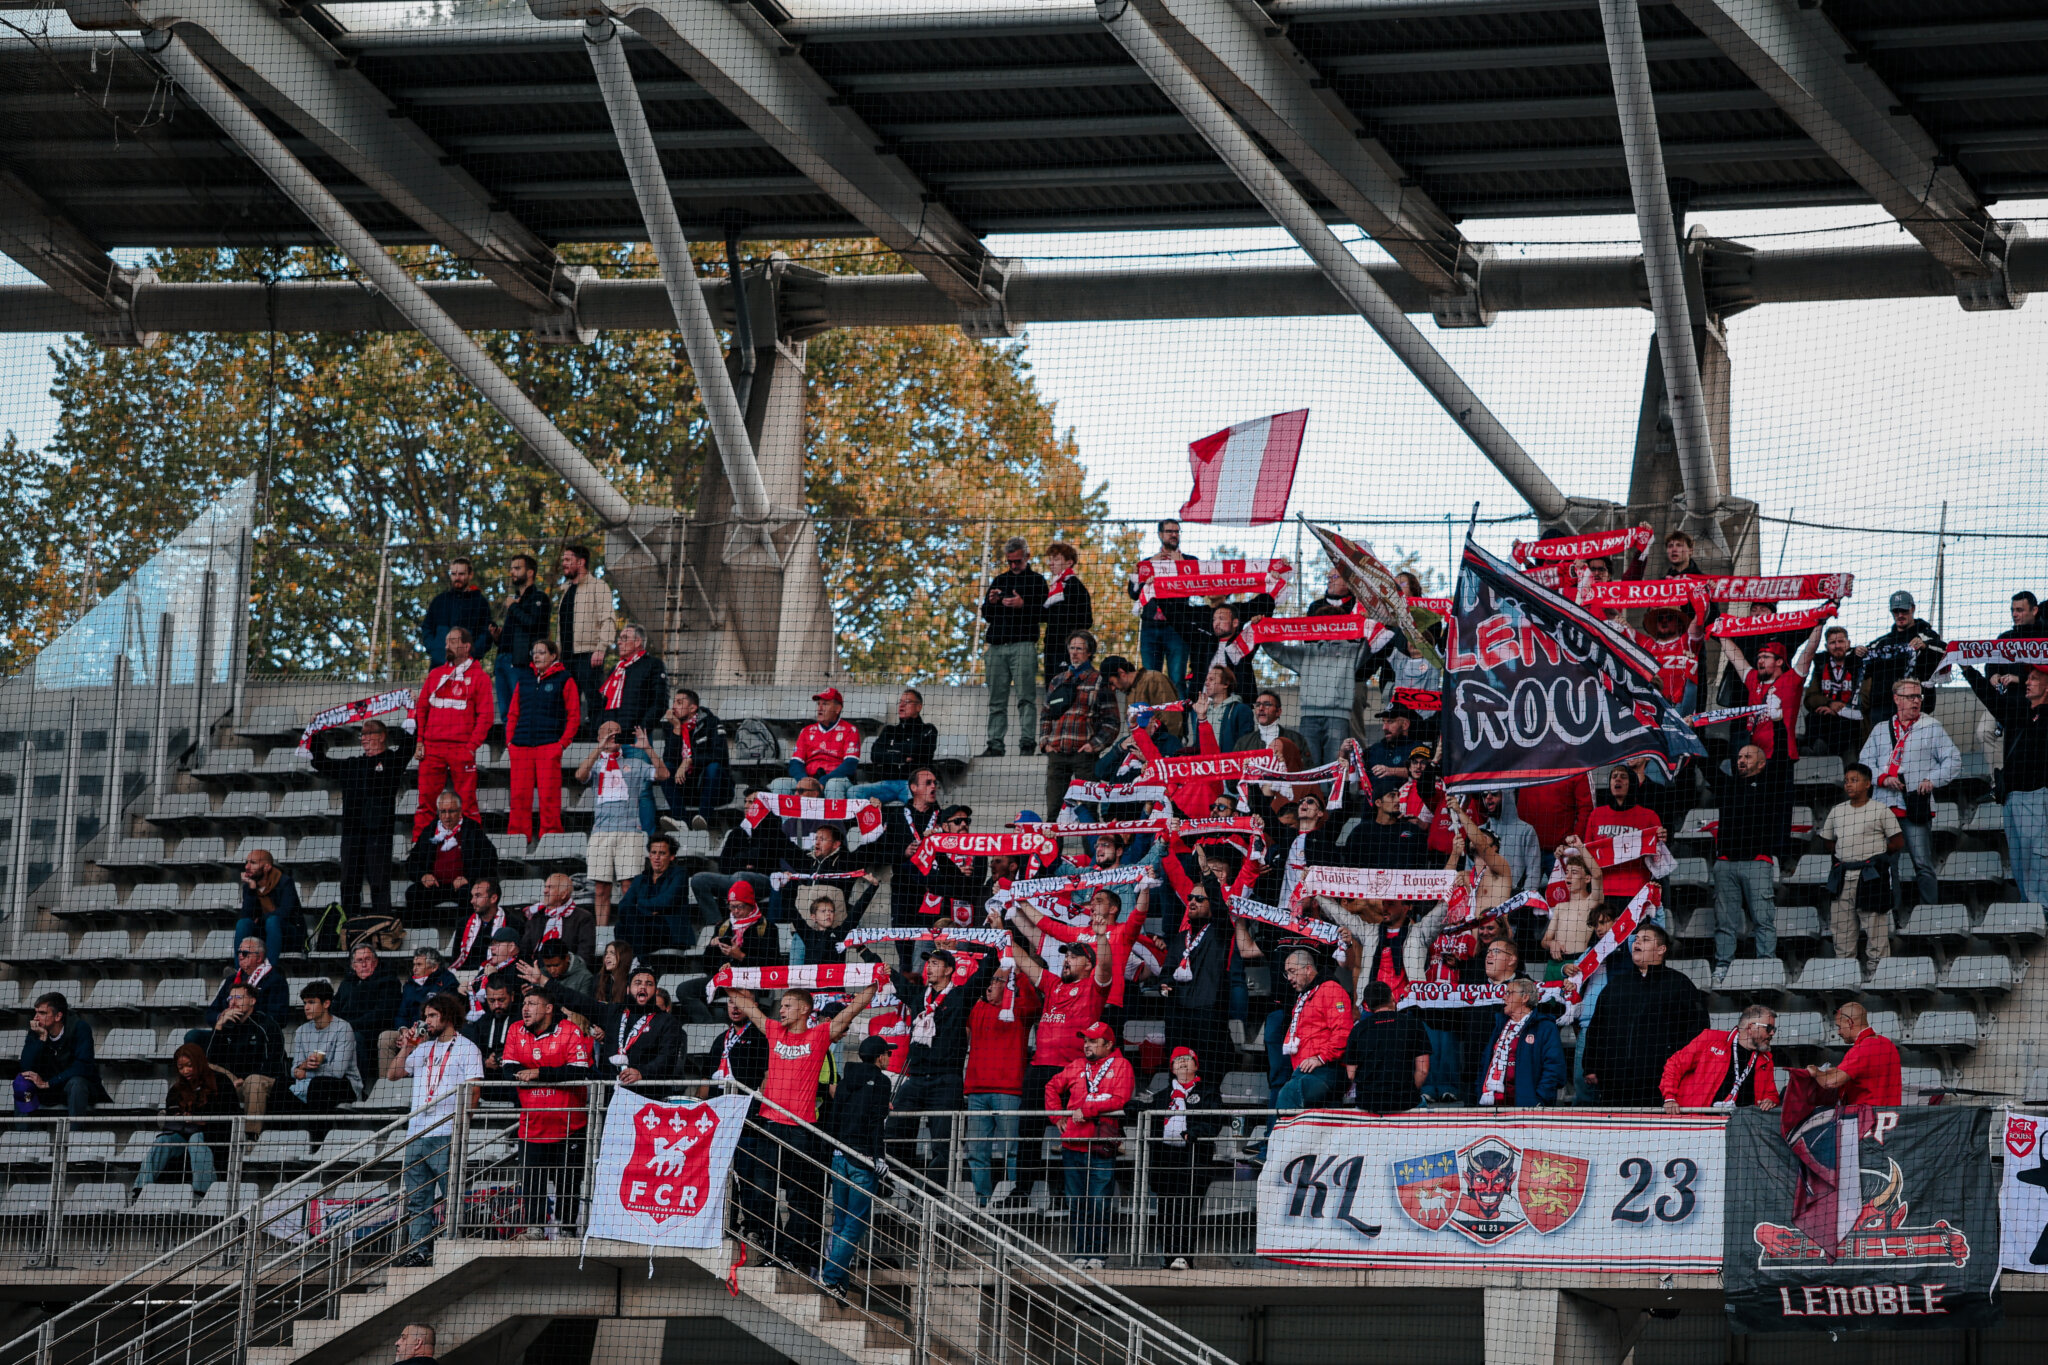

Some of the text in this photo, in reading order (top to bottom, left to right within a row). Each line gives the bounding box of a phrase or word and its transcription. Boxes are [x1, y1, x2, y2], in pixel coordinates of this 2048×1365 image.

[1555, 539, 1601, 557] ROUEN
[1161, 582, 1182, 590] UNE
[1212, 578, 1227, 587] UN
[1597, 585, 1621, 598] FC
[1726, 610, 1810, 627] FC ROUEN
[1258, 624, 1280, 634] UNE
[1311, 623, 1327, 632] UN
[1958, 641, 1993, 658] KOP
[1168, 762, 1190, 777] FC
[1191, 758, 1241, 776] ROUEN
[1012, 833, 1054, 855] 1899
[1315, 871, 1448, 889] Diables Rouges
[1410, 982, 1453, 1001] KOP
[774, 1040, 811, 1058] ROUEN
[1283, 1154, 1698, 1238] KL 23
[627, 1203, 654, 1211] Football
[1478, 1224, 1487, 1232] KL
[1779, 1283, 1950, 1317] LENOBLE
